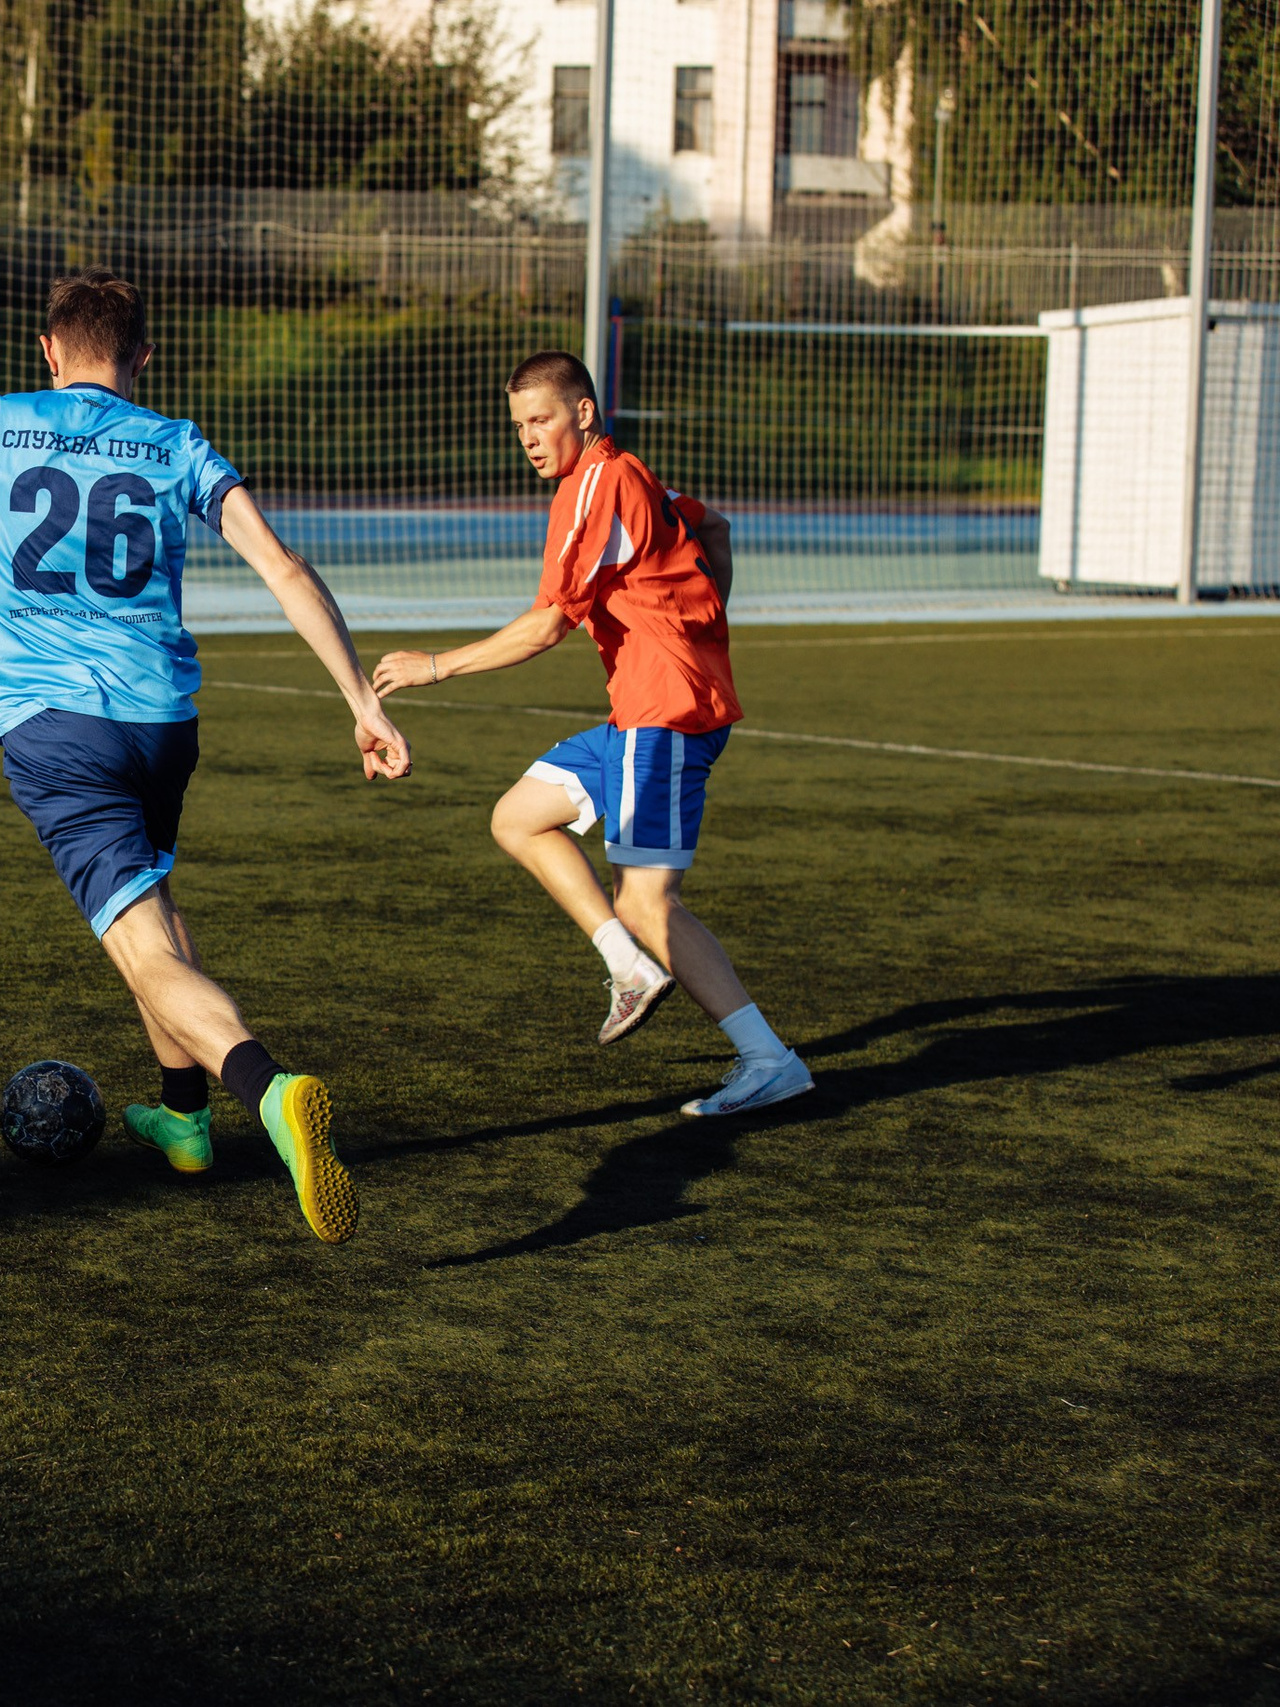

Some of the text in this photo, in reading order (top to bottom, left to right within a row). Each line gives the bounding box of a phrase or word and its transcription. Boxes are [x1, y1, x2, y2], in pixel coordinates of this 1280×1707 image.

[1, 429, 172, 467] СЛУЖБА ПУТИ
[9, 465, 157, 599] 26
